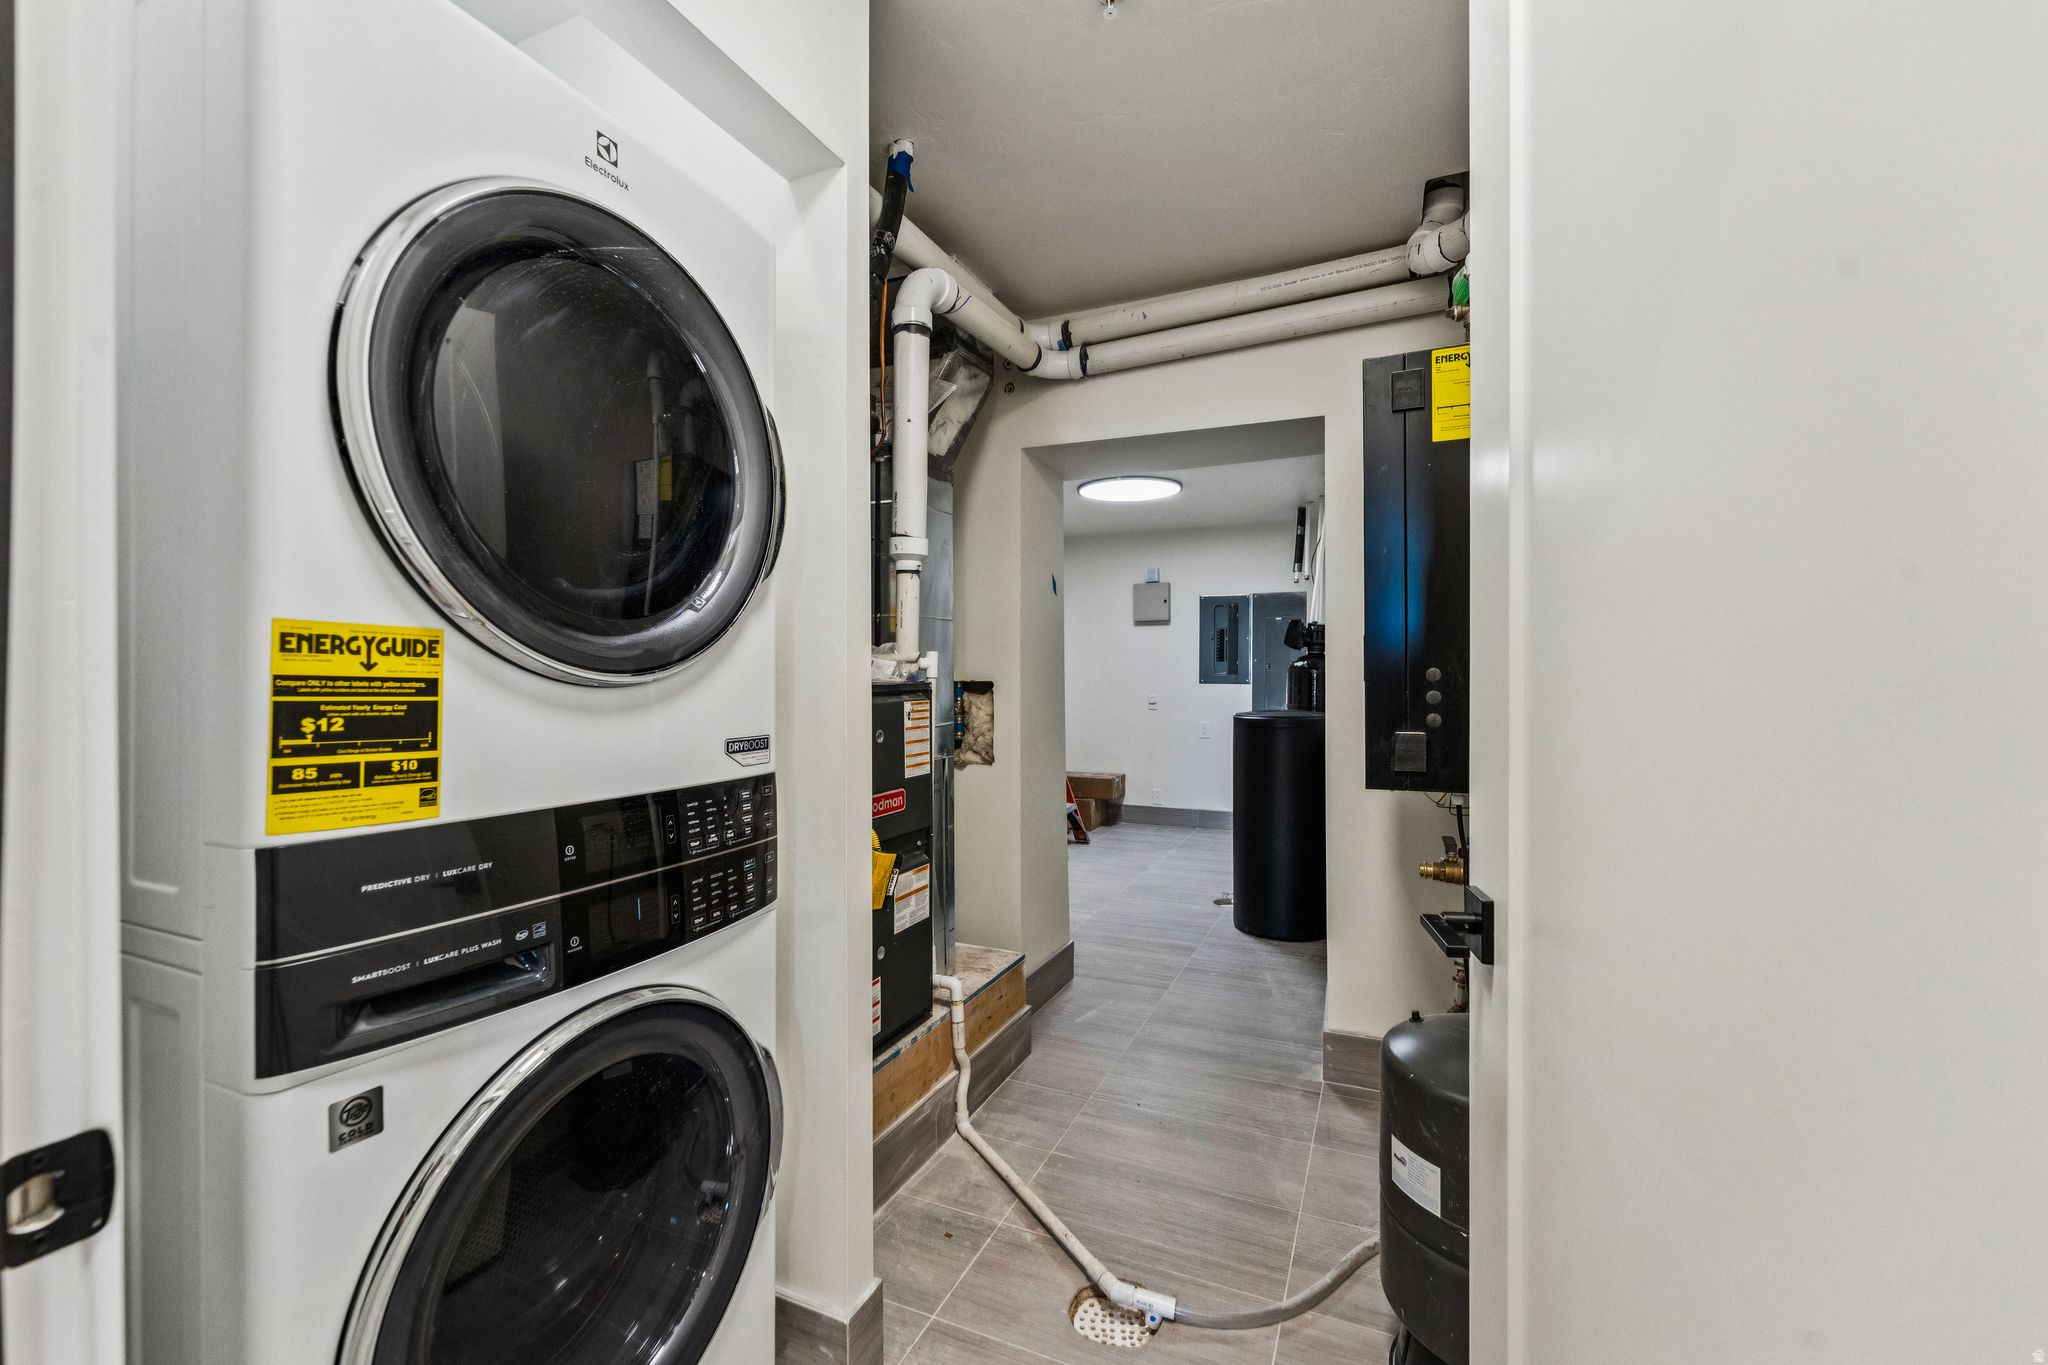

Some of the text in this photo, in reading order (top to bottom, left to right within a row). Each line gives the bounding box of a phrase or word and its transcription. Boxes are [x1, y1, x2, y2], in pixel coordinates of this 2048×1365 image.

[584, 155, 630, 191] Electrolux
[1435, 351, 1470, 365] ENERGY
[279, 631, 440, 659] ENERGYGUIDE
[300, 717, 345, 734] $12
[728, 739, 768, 752] DRYBOOST
[291, 767, 318, 780] 85
[391, 760, 418, 772] $10
[873, 796, 903, 812] odman
[361, 862, 493, 893] PREDICTIVE DRY LUXCARE DRY
[352, 939, 502, 984] SMARTBOOST LUXCARE PLUS WASH
[338, 1122, 374, 1142] COLD
